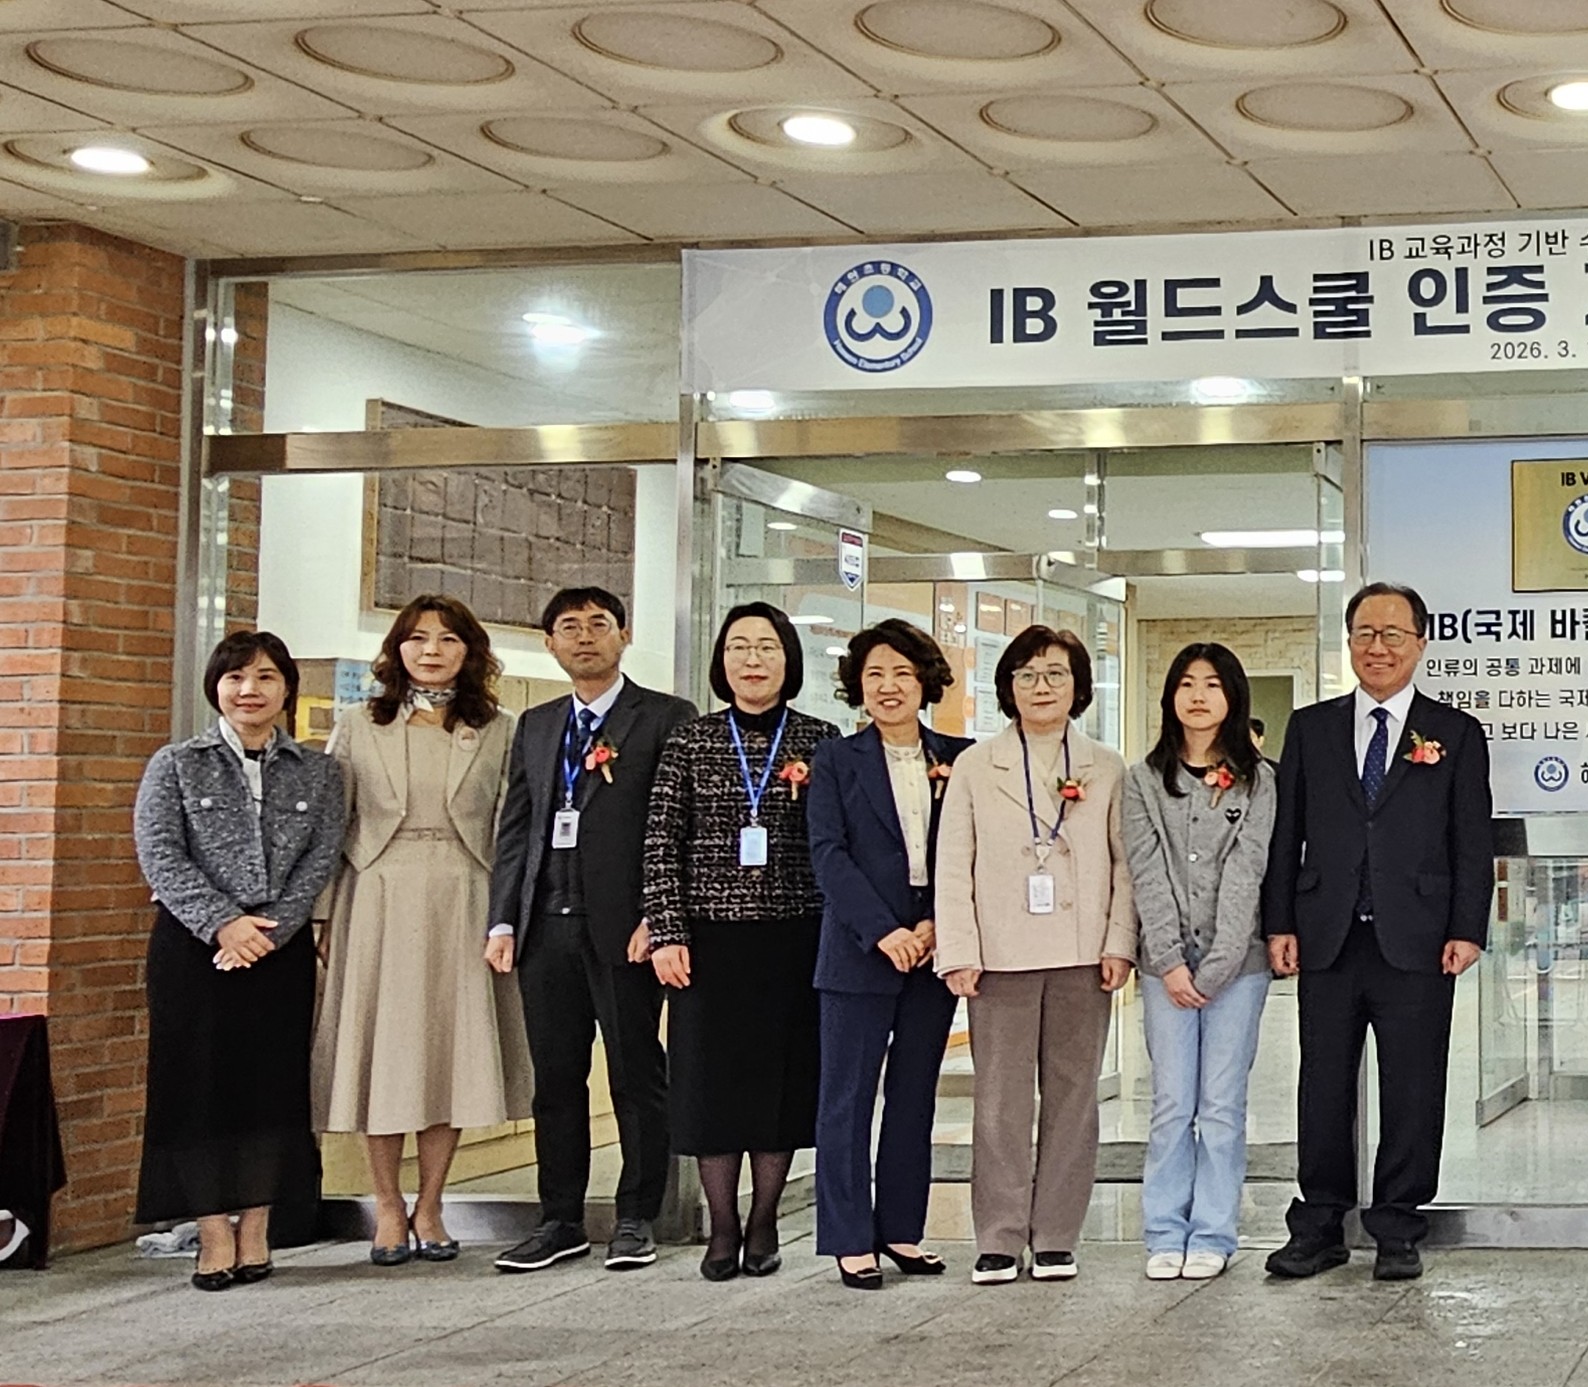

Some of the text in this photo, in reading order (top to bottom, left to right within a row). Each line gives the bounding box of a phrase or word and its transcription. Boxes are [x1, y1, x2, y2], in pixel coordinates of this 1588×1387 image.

[1369, 238, 1395, 261] IB
[1403, 230, 1506, 261] 교육과정
[1518, 228, 1569, 257] 기반
[989, 287, 1058, 344] IB
[1087, 271, 1375, 347] 월드스쿨
[1407, 264, 1550, 337] 인증
[1490, 341, 1549, 360] 2026.
[1557, 339, 1577, 358] 3.
[1560, 472, 1576, 487] IB
[1428, 608, 1535, 644] IB(국제
[1426, 658, 1478, 678] 인류의
[1485, 657, 1521, 677] 공통
[1528, 656, 1581, 676] 과제에
[1498, 689, 1552, 709] 다하는
[1500, 721, 1538, 741] 보다
[1543, 721, 1579, 741] 나은
